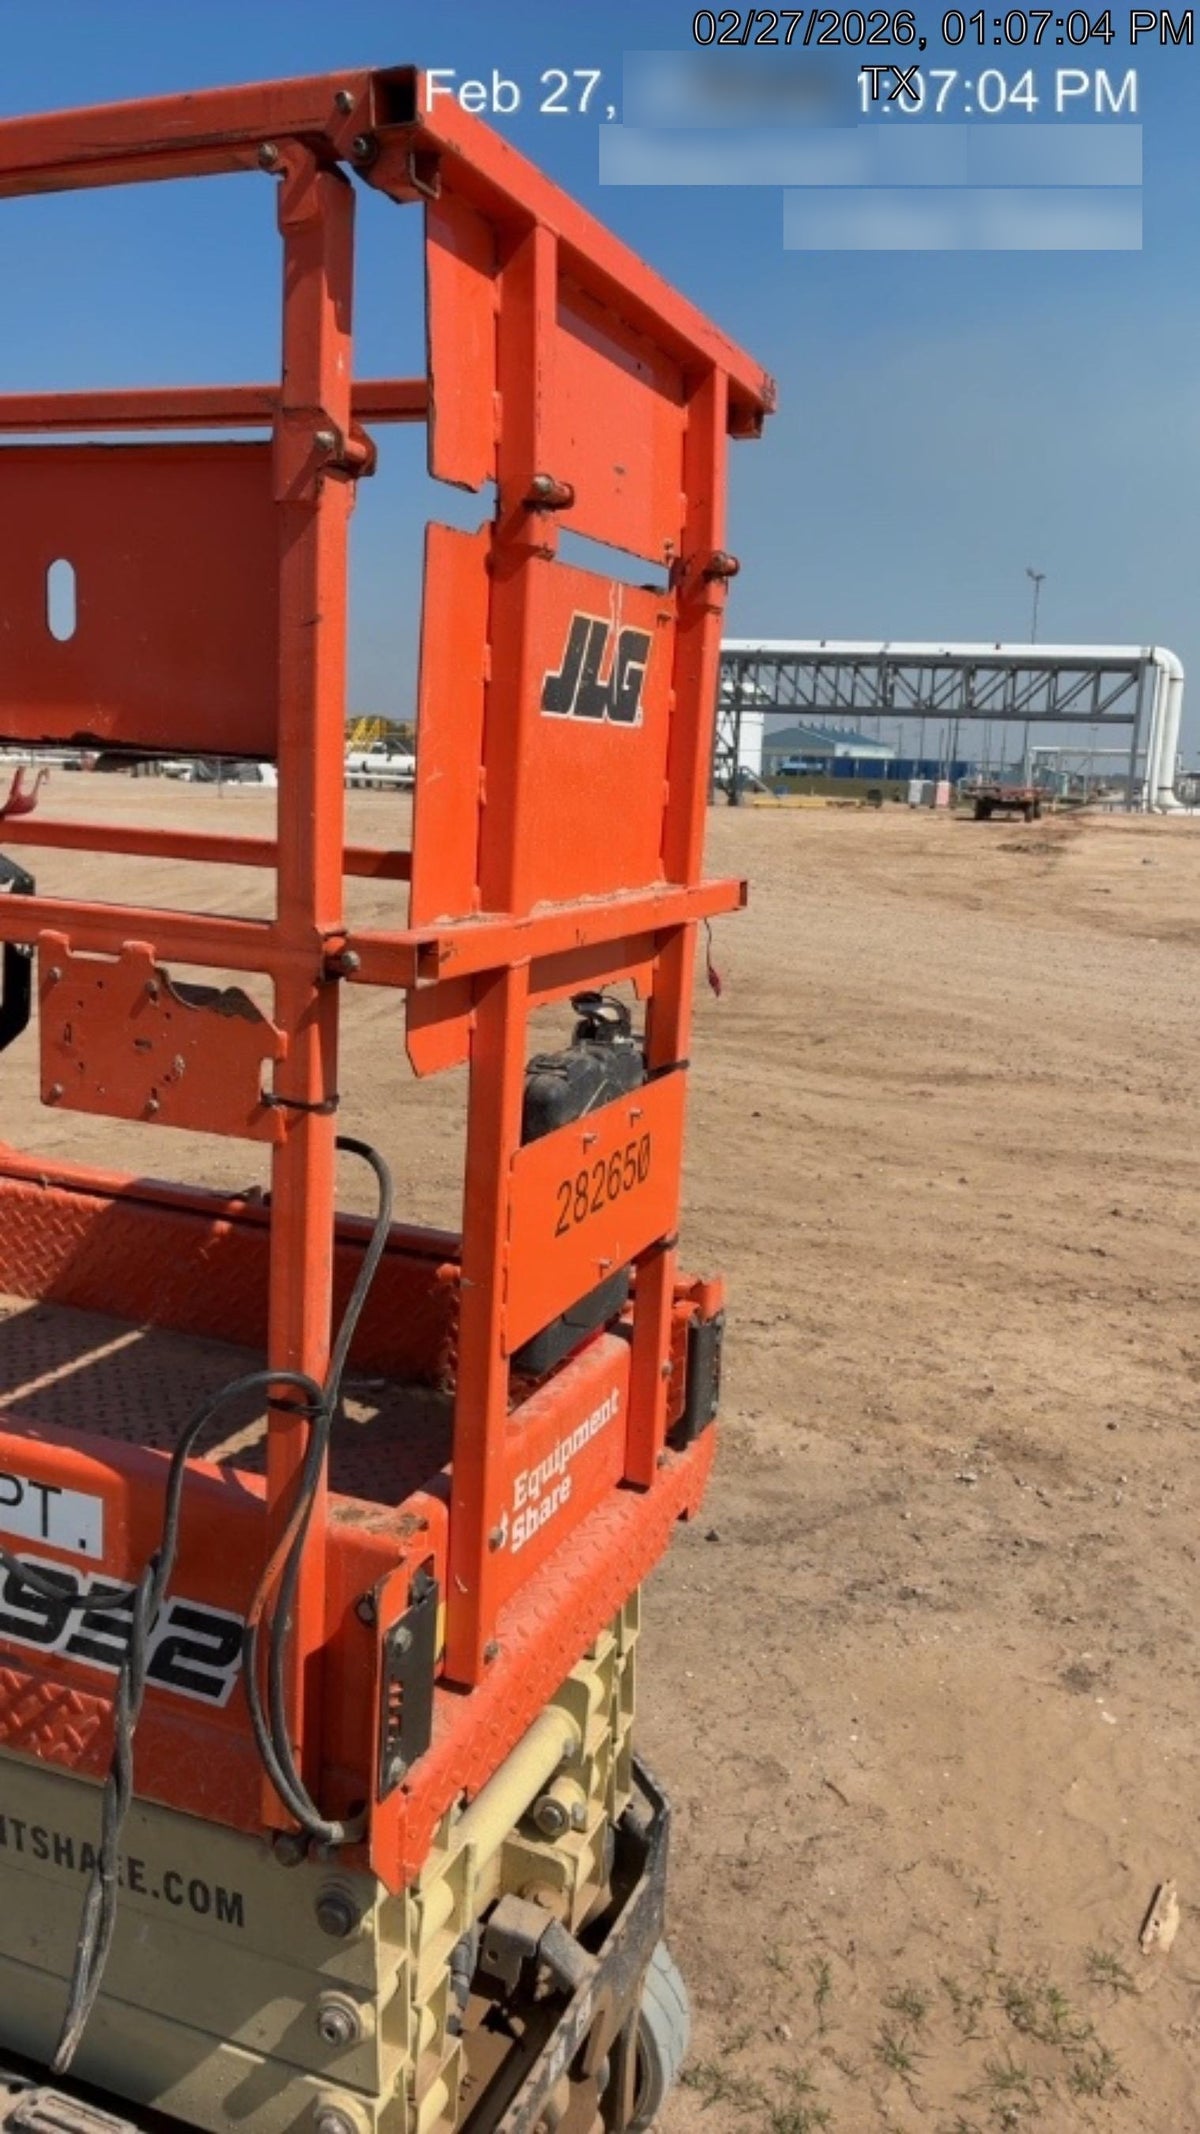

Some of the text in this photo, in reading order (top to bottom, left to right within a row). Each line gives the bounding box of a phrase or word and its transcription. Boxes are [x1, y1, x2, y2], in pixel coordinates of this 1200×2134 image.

[540, 611, 653, 725] JLG
[555, 1131, 651, 1238] 282650
[513, 1387, 620, 1511] Equipment
[511, 1475, 572, 1554] Share
